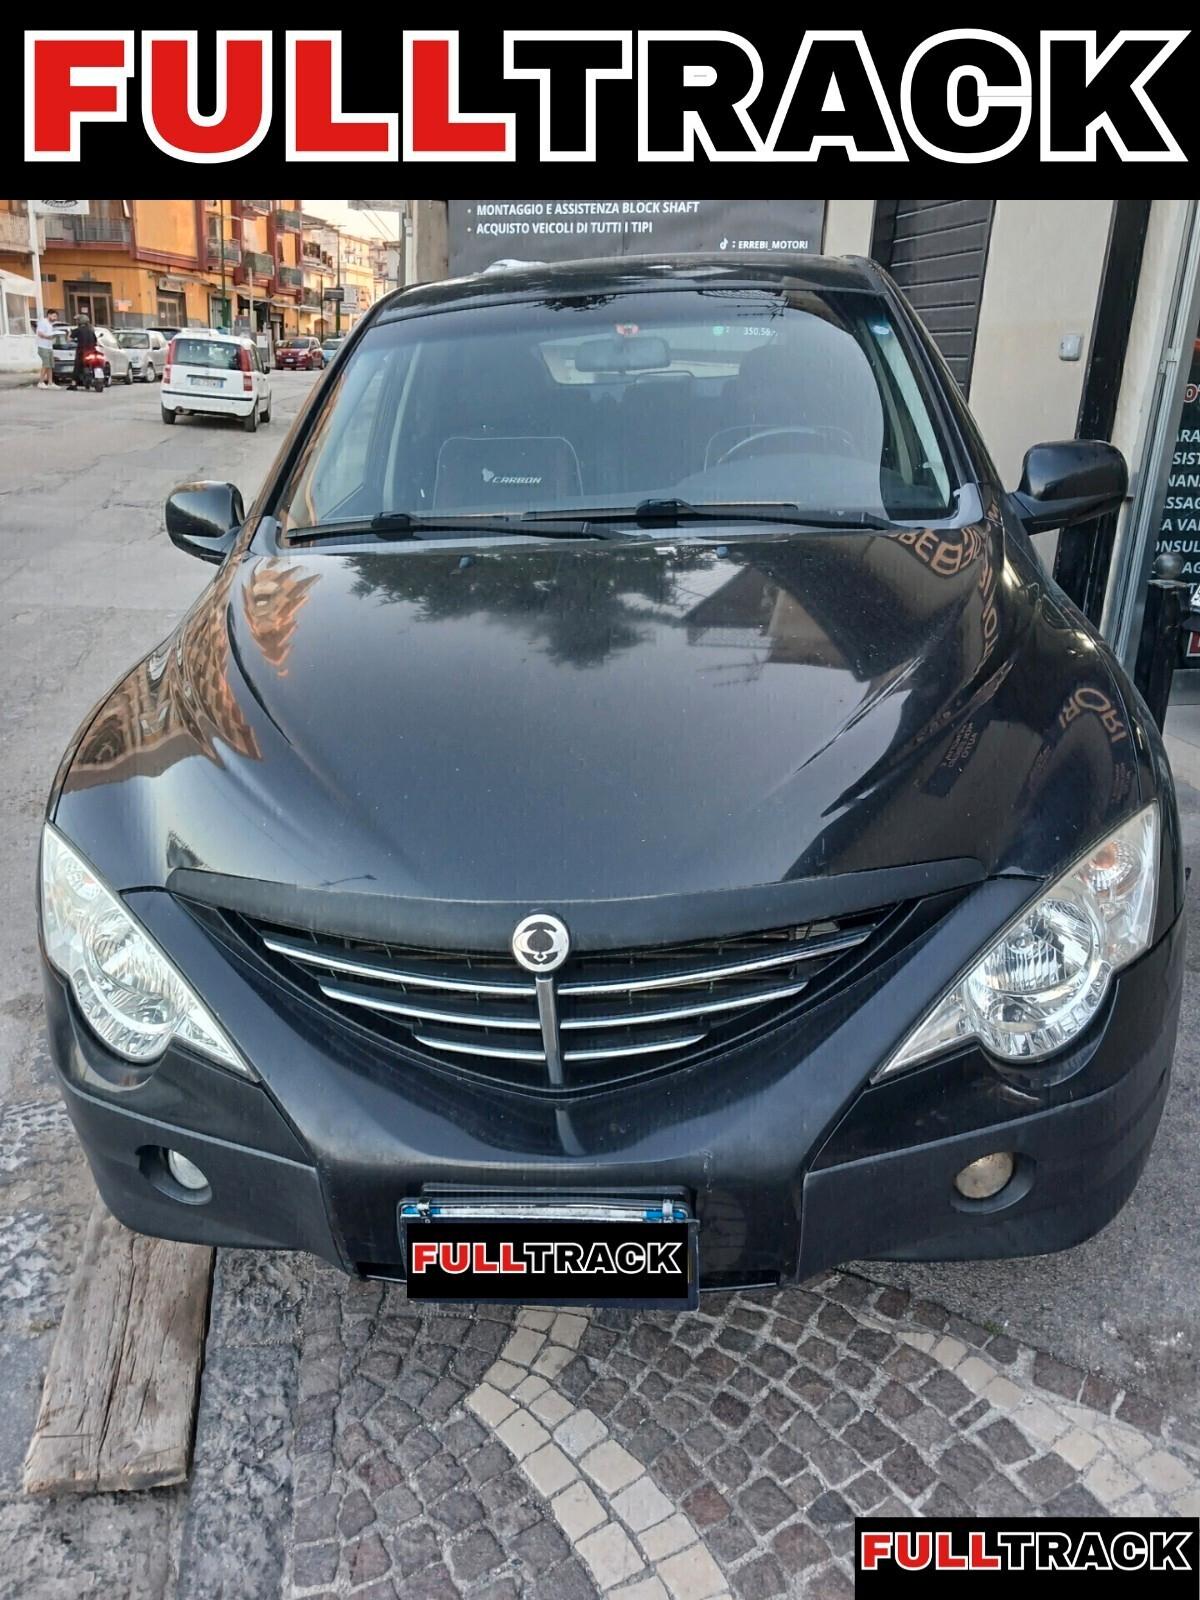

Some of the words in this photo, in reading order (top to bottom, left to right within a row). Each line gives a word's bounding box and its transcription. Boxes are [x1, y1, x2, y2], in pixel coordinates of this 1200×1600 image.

[476, 204, 543, 216] MONTAGGIO
[546, 203, 553, 215] E
[554, 202, 620, 215] ASSISTENZA
[622, 202, 660, 214] BLOCK
[662, 201, 700, 214] SHAFT
[476, 222, 530, 236] ACQUISTO
[532, 222, 574, 234] VEICOLI
[576, 222, 588, 233] DI
[591, 221, 622, 233] TUTTI
[624, 221, 629, 233] I
[631, 221, 653, 233] TIPI
[492, 476, 542, 484] CARBON
